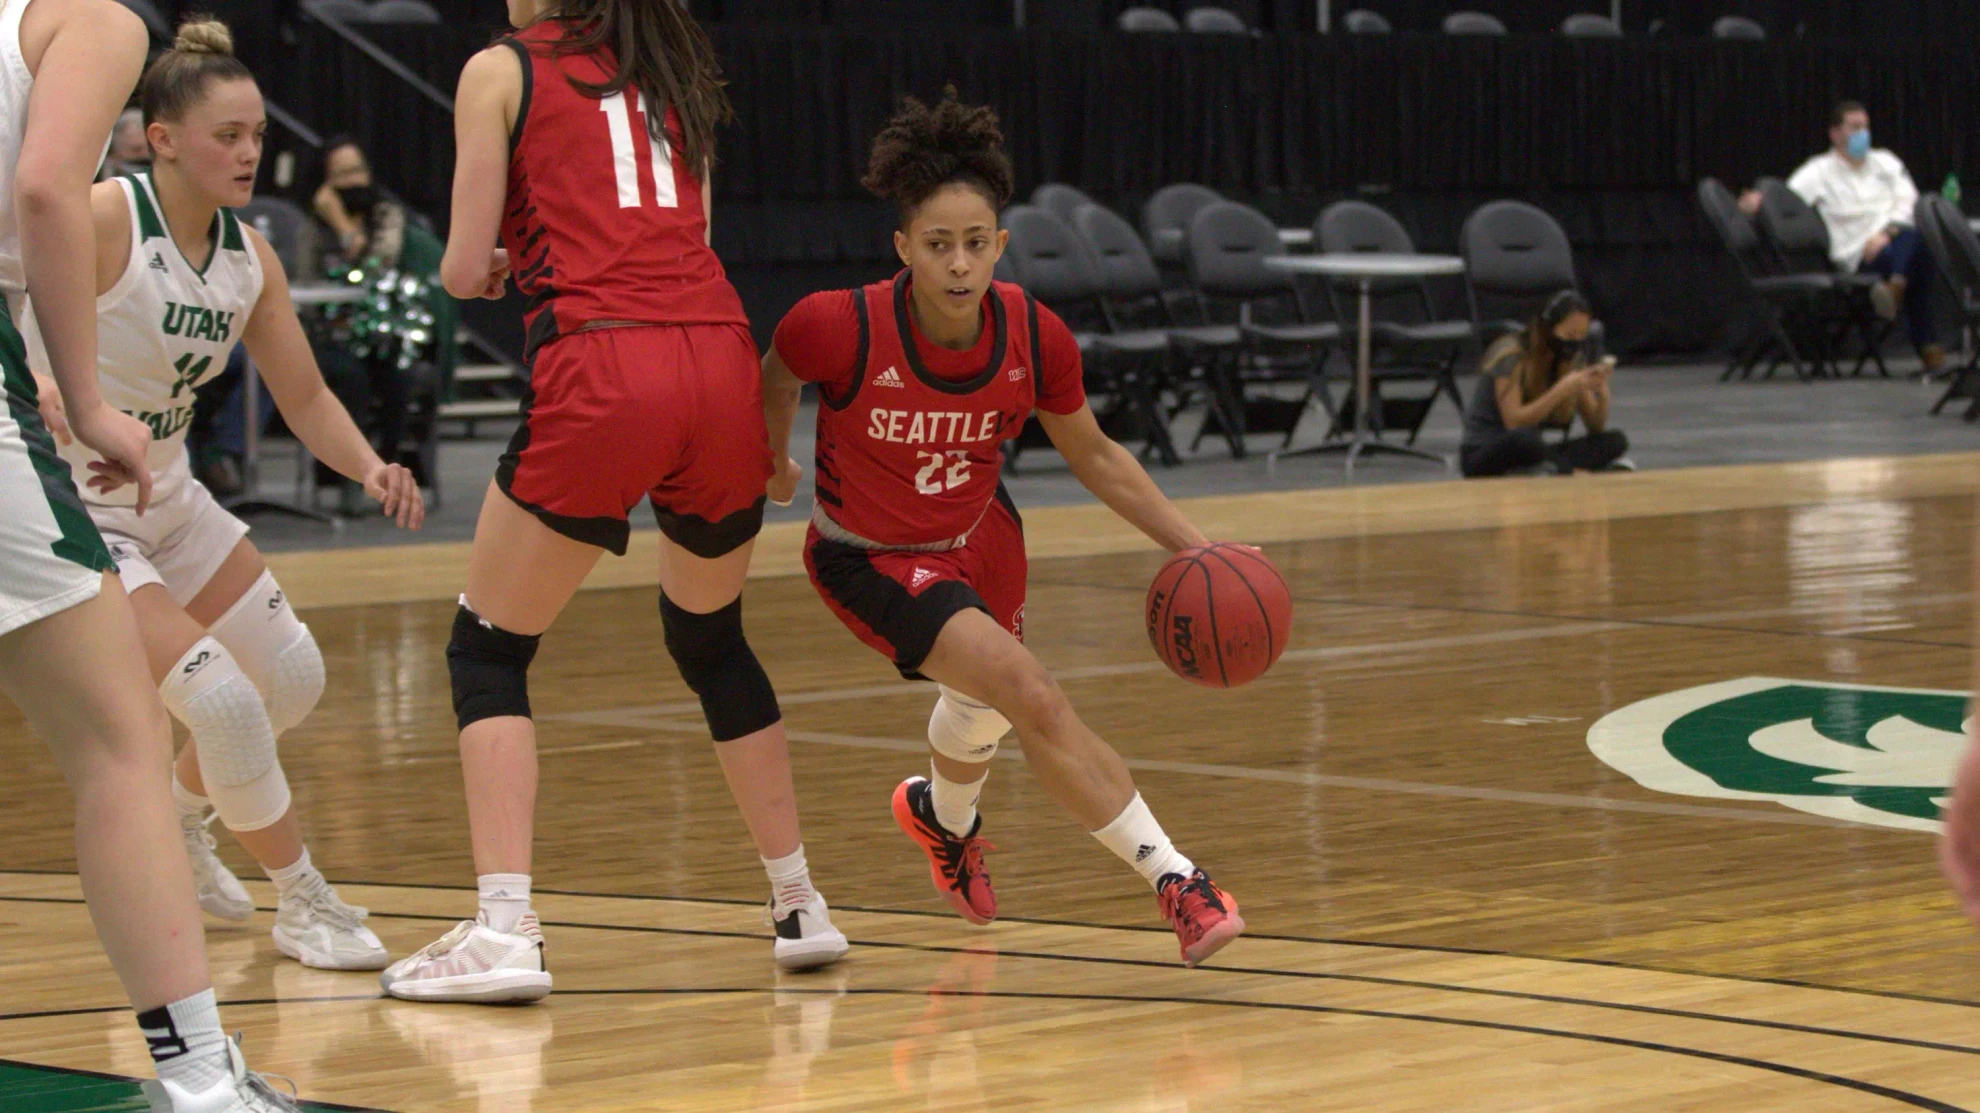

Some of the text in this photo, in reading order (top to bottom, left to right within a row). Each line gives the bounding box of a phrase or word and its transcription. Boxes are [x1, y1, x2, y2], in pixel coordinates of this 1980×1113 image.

[599, 88, 678, 208] 11
[162, 301, 235, 342] UTAH
[872, 379, 905, 389] adidas
[868, 407, 998, 444] SEATTLE
[915, 449, 971, 495] 22
[1173, 615, 1204, 679] NCAA
